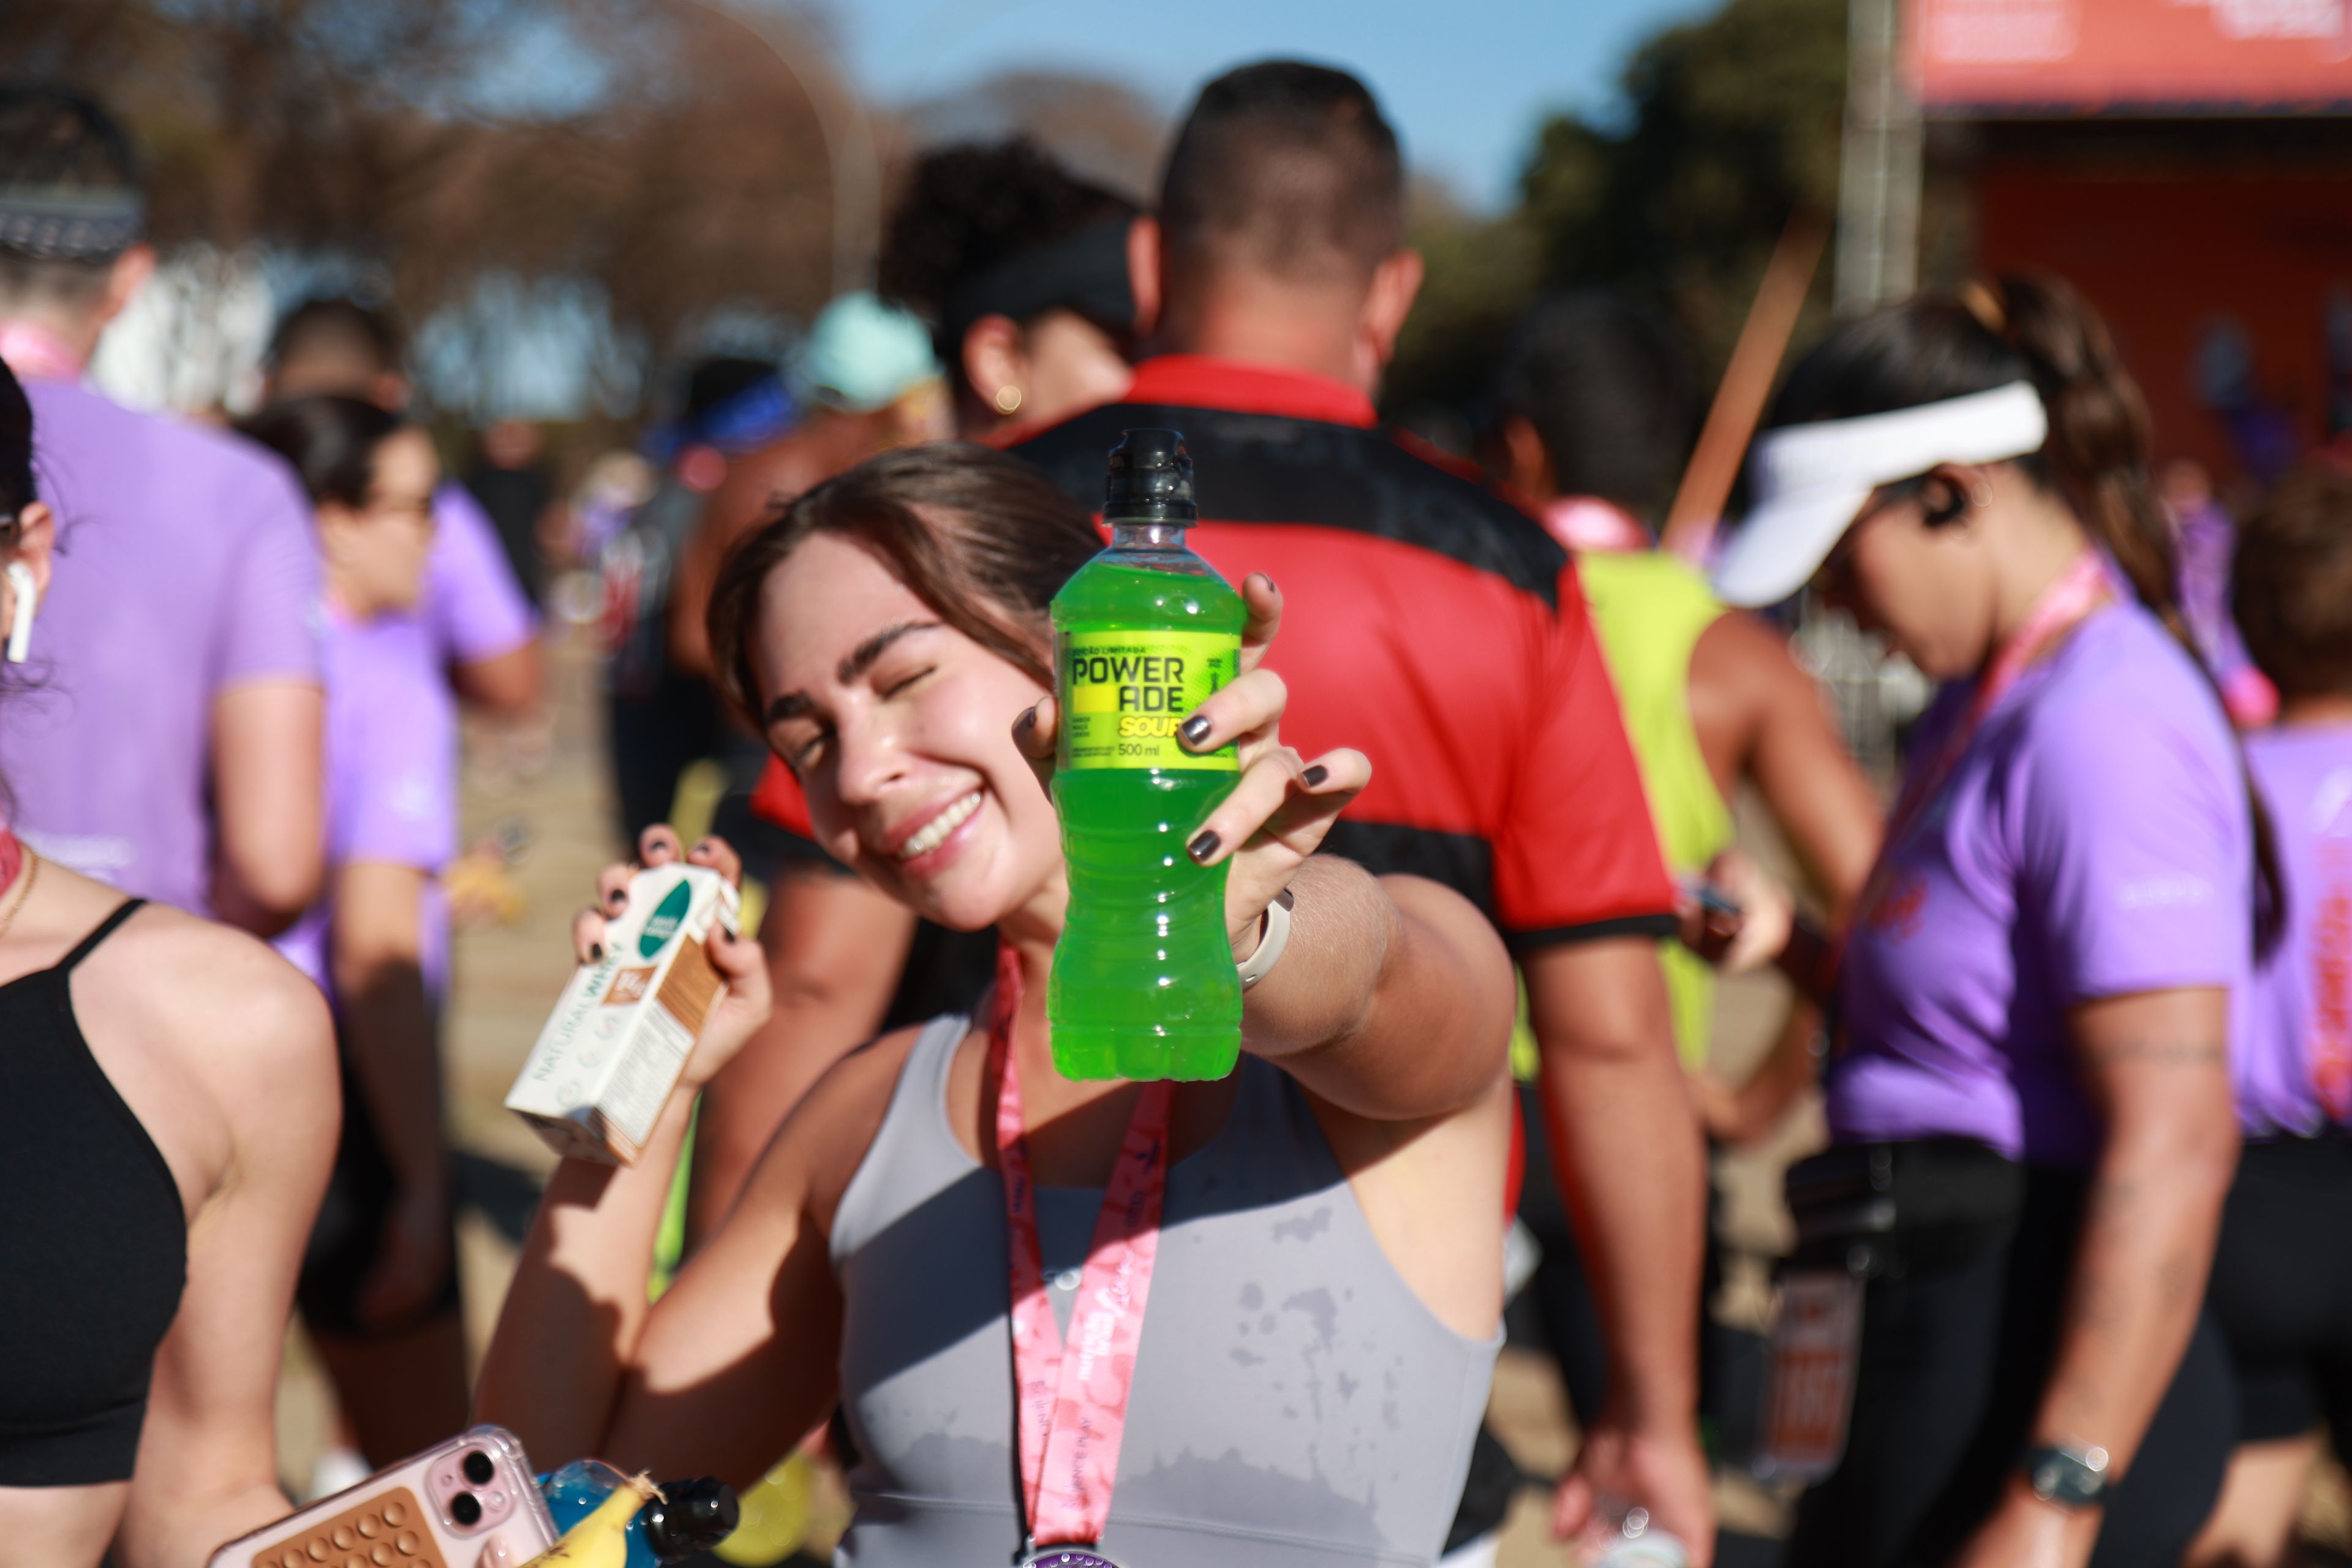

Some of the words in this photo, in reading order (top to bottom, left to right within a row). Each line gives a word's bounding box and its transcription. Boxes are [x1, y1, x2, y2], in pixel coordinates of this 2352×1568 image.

[1072, 657, 1185, 685] POWER
[1119, 685, 1183, 712] ADE
[1118, 744, 1142, 756] 500
[1145, 745, 1160, 756] ml
